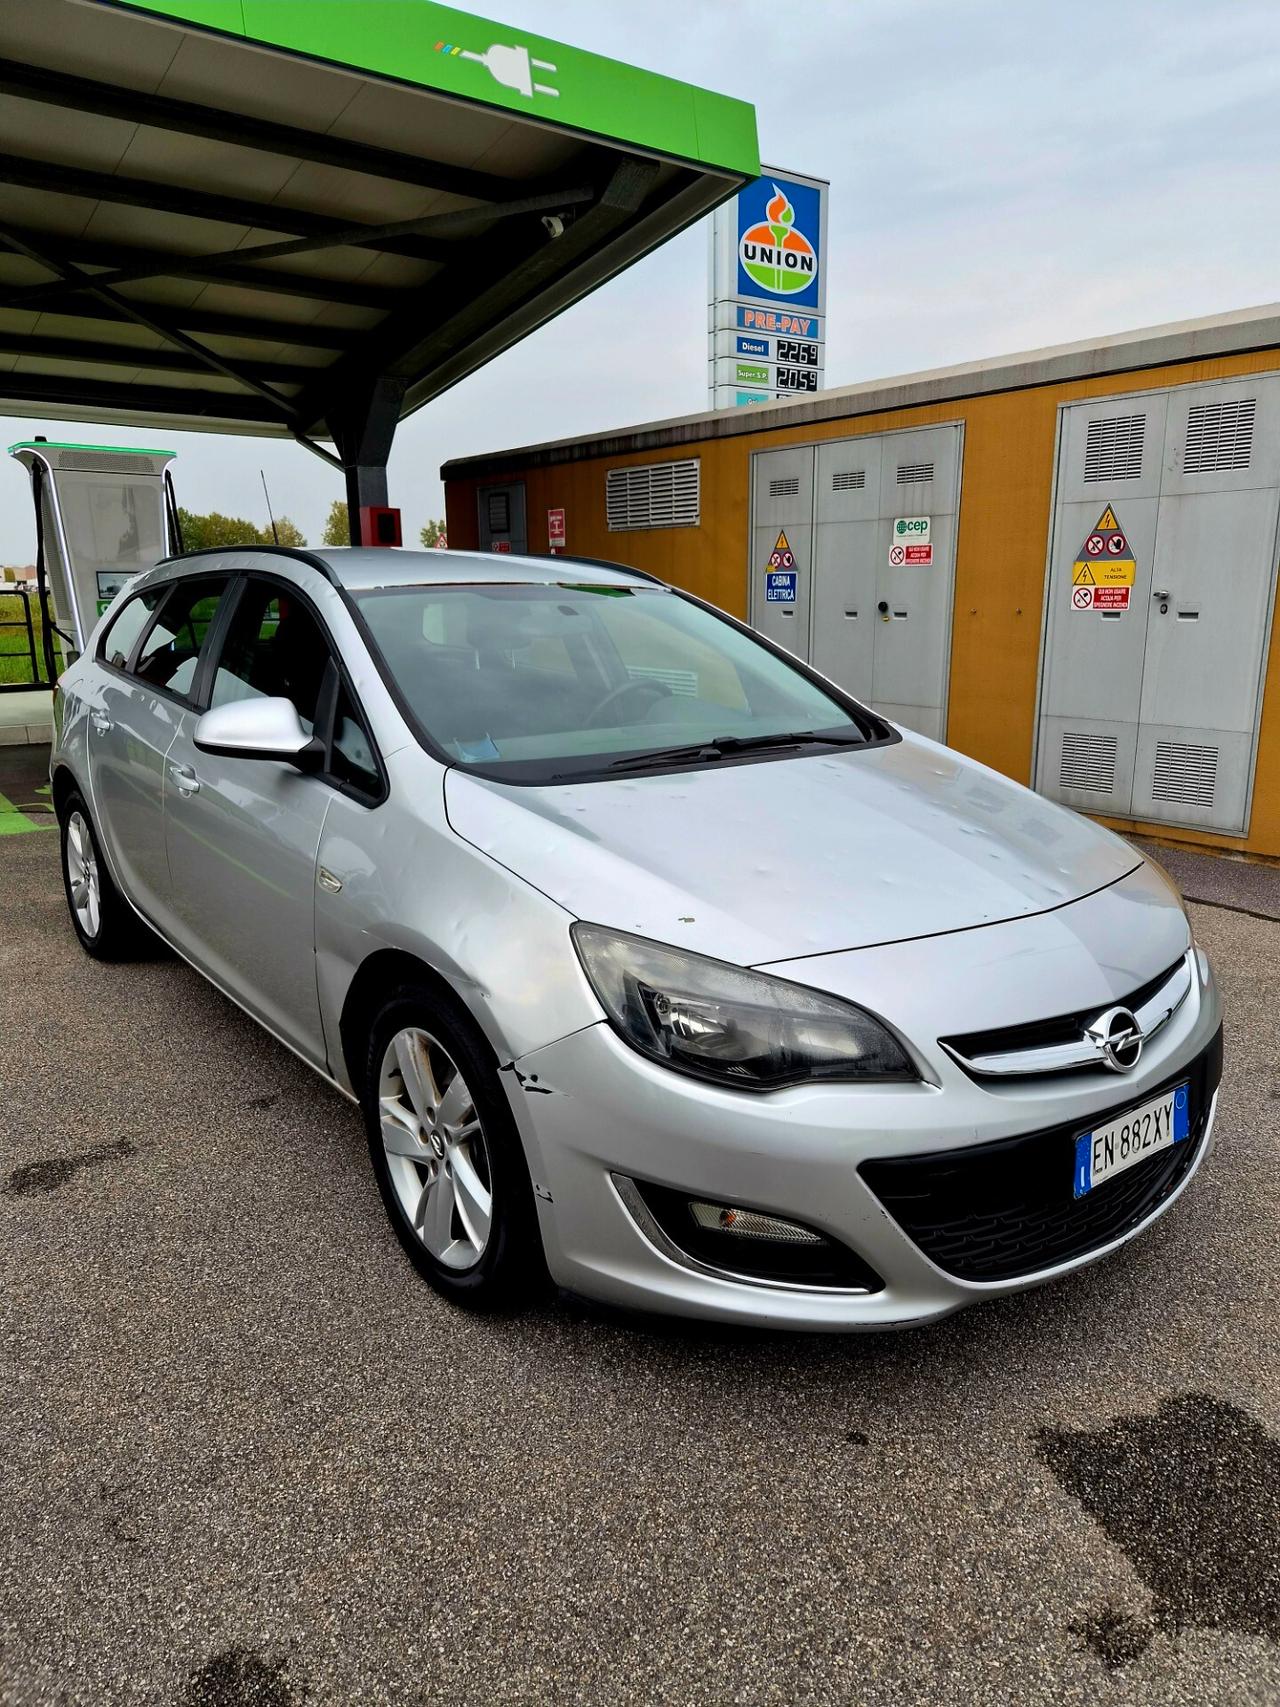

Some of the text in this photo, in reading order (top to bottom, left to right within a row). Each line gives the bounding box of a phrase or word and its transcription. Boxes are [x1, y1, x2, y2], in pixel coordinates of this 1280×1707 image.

[744, 244, 813, 272] UNION
[744, 309, 811, 336] PRE-PAY
[742, 342, 764, 353] Diesel
[738, 369, 756, 378] Super
[907, 520, 928, 534] cep
[771, 575, 791, 587] CABINA
[768, 588, 795, 600] ELETTRICA
